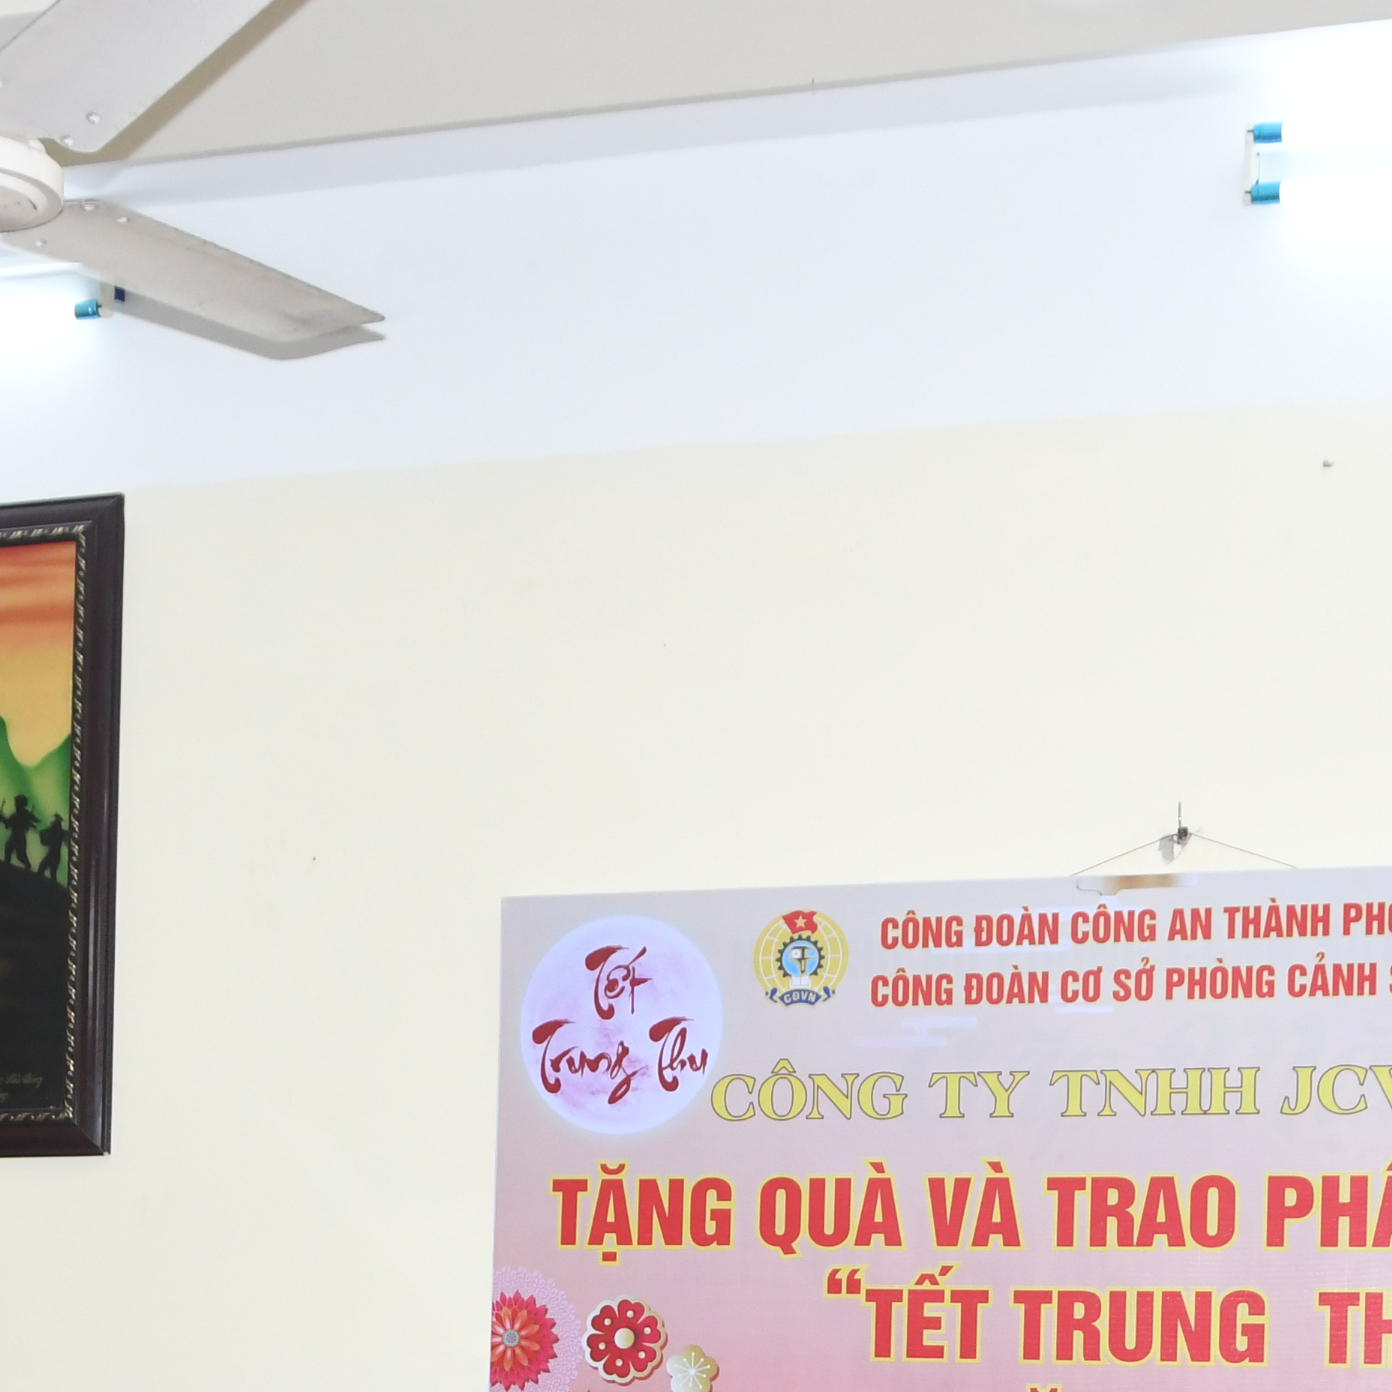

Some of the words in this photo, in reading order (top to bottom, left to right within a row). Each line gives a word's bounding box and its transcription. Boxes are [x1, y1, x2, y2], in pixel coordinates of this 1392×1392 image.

[881, 910, 964, 950] CÔNG
[974, 905, 1059, 947] ĐOÀN
[1071, 904, 1157, 943] CÔNG
[1168, 907, 1212, 941] AN
[1224, 897, 1330, 939] THÀNH
[871, 968, 954, 1007] CÔNG
[964, 965, 1049, 1005] ĐOÀN
[1060, 966, 1103, 1003] CƠ
[1112, 957, 1156, 1001] SỞ
[1165, 958, 1275, 1000] PHÒNG
[1287, 952, 1377, 997] CẢNH
[532, 1018, 649, 1105] Trung
[649, 1016, 708, 1092] Thu
[711, 1058, 908, 1121] CÔNG
[929, 1071, 1030, 1119] TY
[1049, 1067, 1260, 1118] TNHH
[550, 1161, 735, 1264] TẶNG
[757, 1159, 905, 1256] QUÀ
[925, 1159, 1024, 1250] VÀ
[1044, 1173, 1238, 1250] TRAO
[1010, 1288, 1270, 1365] TRUNG
